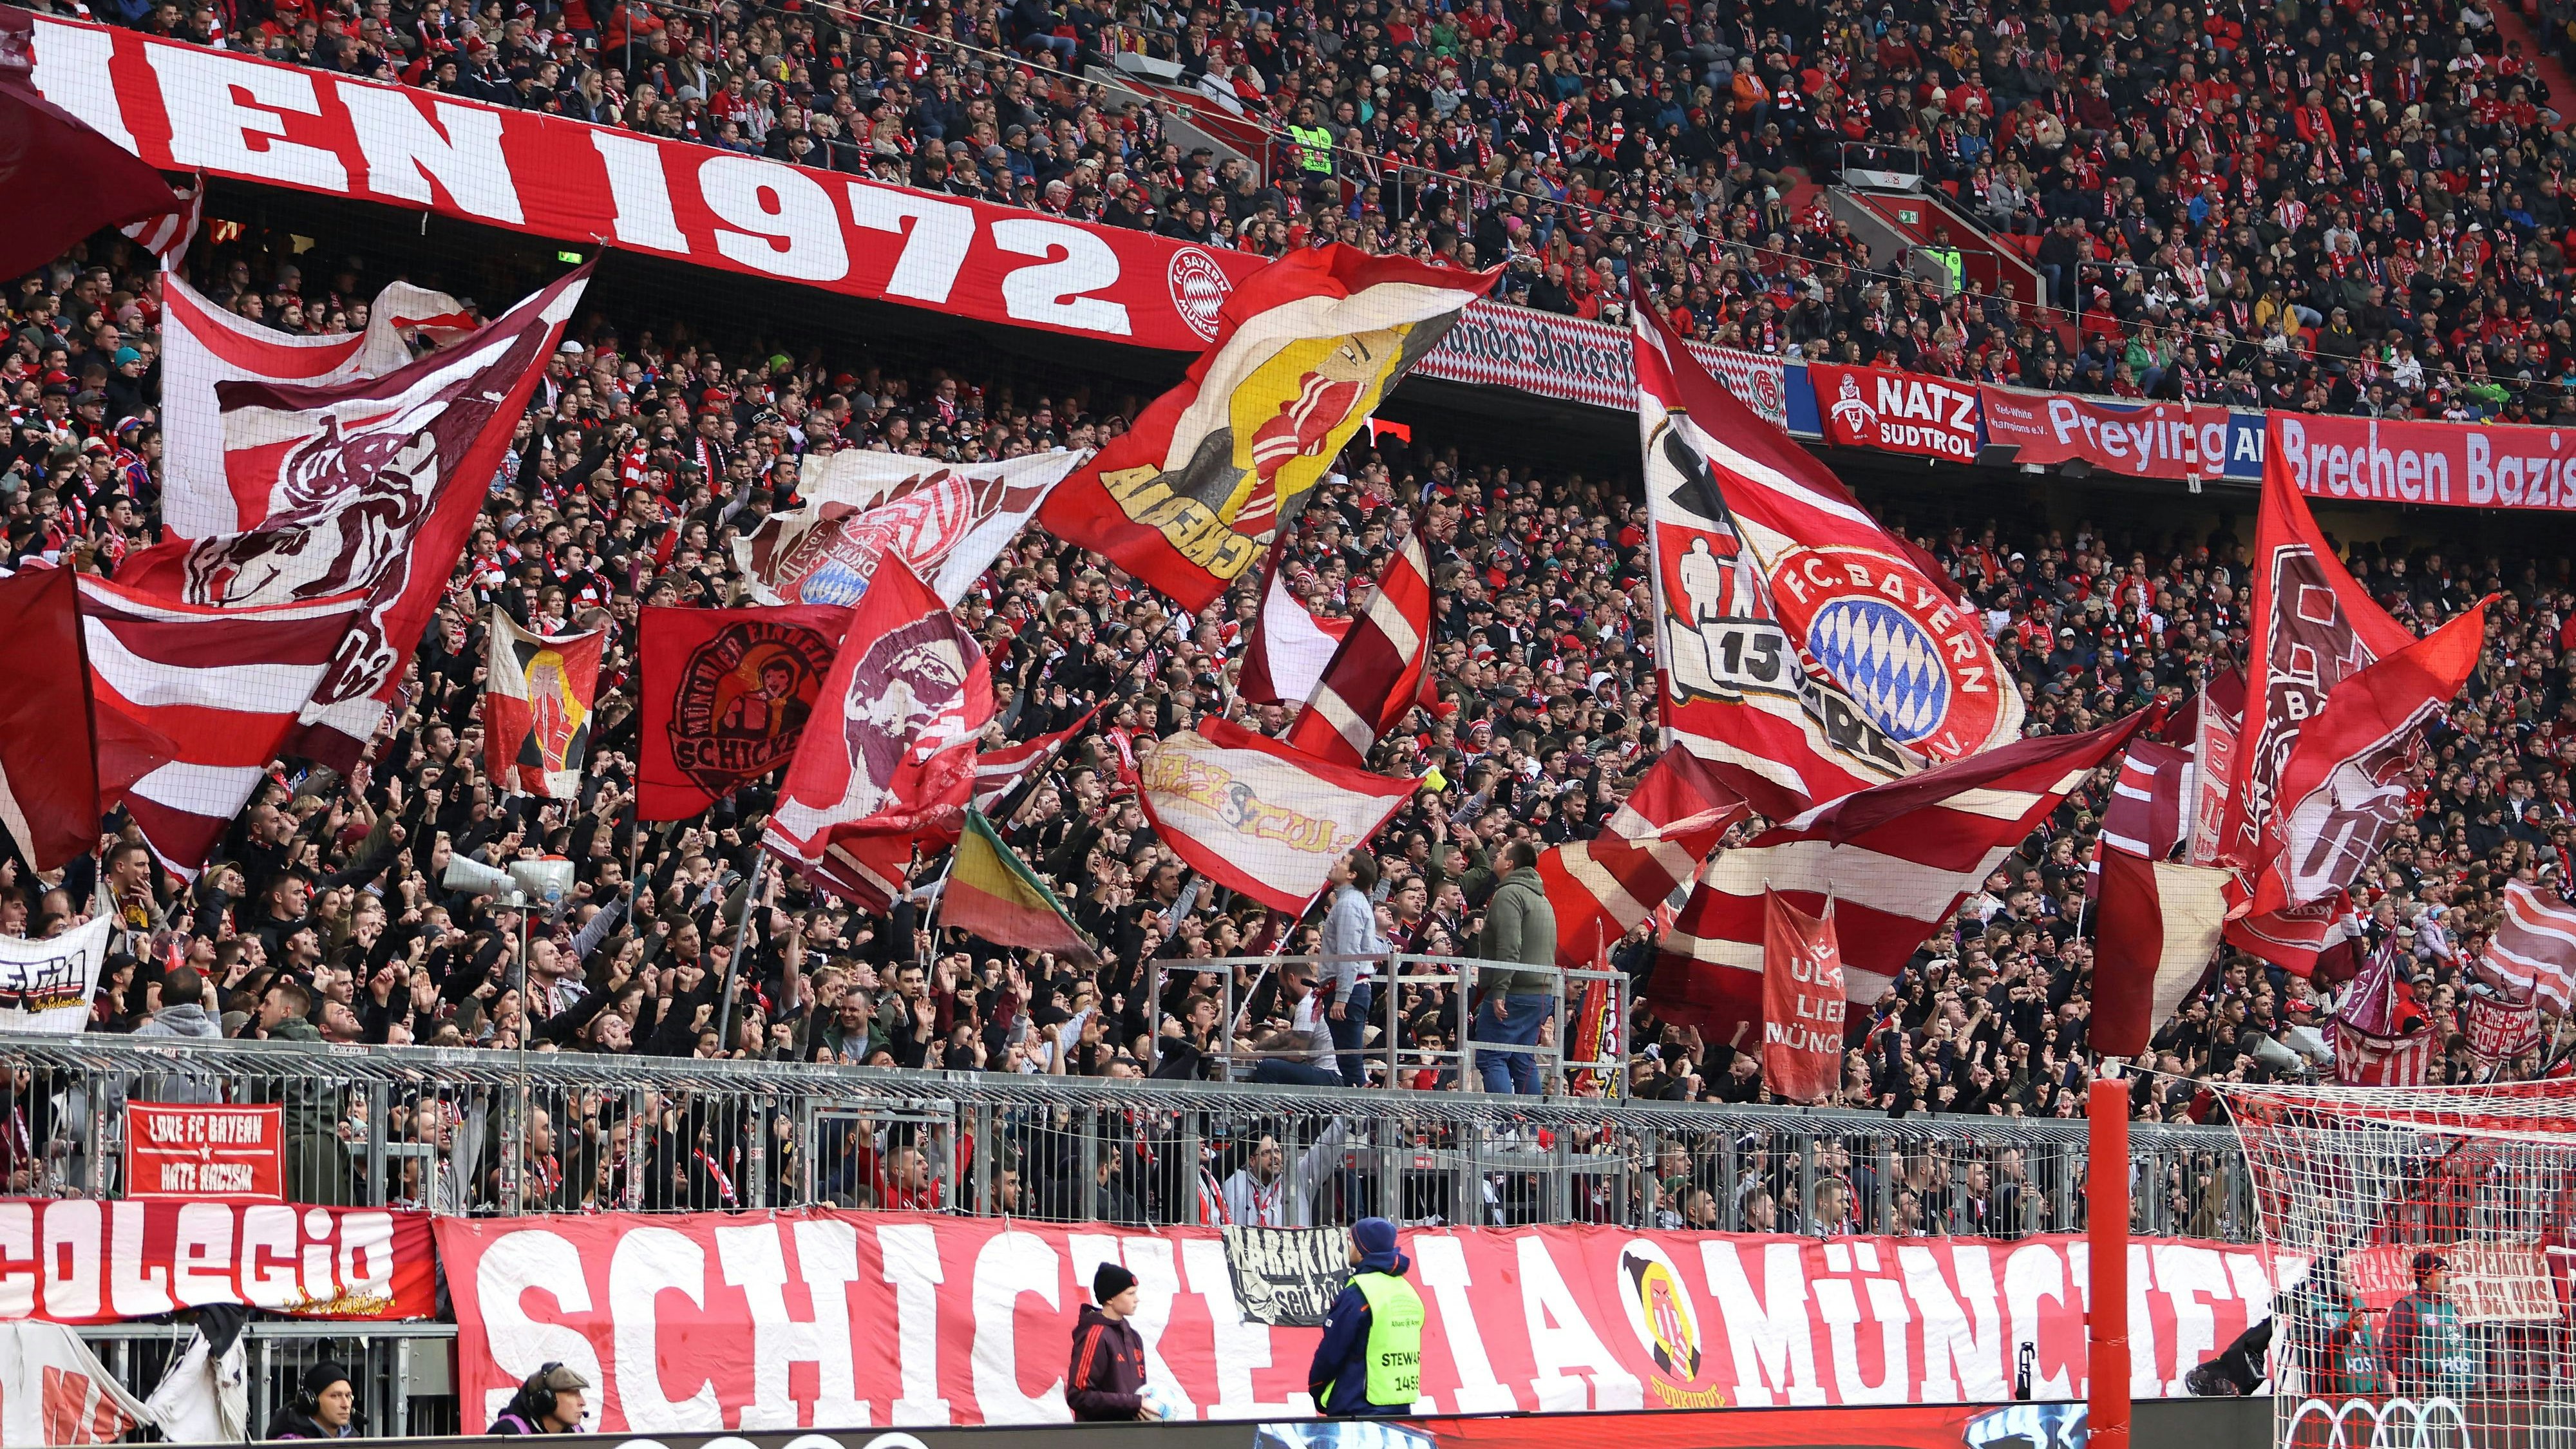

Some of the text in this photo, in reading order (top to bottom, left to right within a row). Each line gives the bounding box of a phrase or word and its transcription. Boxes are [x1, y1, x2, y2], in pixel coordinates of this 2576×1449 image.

[590, 129, 1132, 336] 1972
[1182, 256, 1228, 292] BAYERN
[1178, 299, 1220, 336] MÜNCH
[1877, 375, 1976, 433] NATZ
[1995, 403, 2033, 420] Red-White
[2031, 424, 2048, 435] e.V.
[2282, 418, 2450, 502] Brechen
[1844, 562, 1989, 696] BAYERN
[1720, 630, 1783, 683] 15
[147, 1114, 263, 1144] LOVE FC BAYERN
[160, 1162, 254, 1192] HATE RACISM
